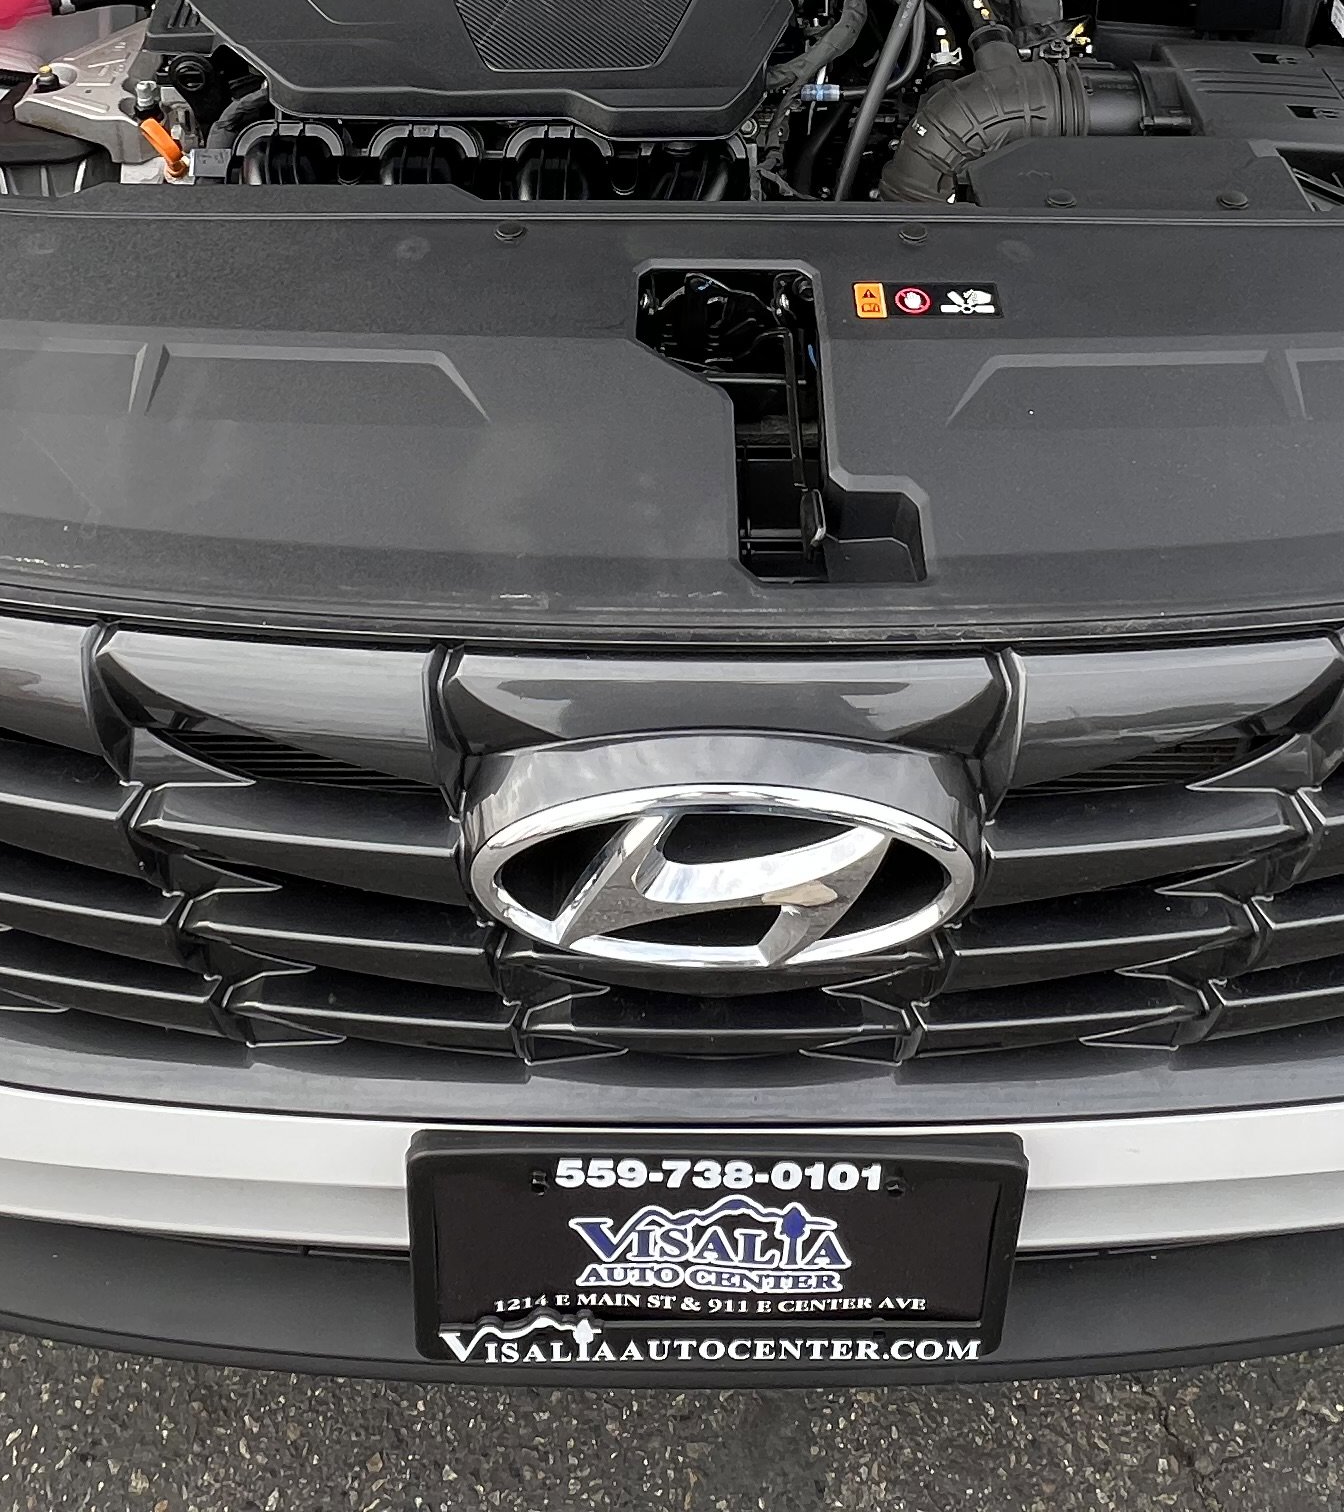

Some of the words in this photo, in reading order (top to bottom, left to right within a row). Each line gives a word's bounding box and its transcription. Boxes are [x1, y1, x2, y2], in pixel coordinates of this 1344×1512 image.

[555, 1158, 883, 1190] 559-738-0101
[569, 1196, 852, 1269] VISALIA
[576, 1263, 684, 1286] AUTO
[684, 1265, 843, 1292] CENTER
[494, 1293, 549, 1313] 1214
[556, 1294, 570, 1306] E
[577, 1293, 641, 1307] MAIN
[647, 1295, 676, 1310] ST
[680, 1297, 701, 1311] &
[708, 1298, 748, 1313] 911
[756, 1299, 772, 1313] E
[777, 1297, 873, 1312] CENTER
[878, 1297, 926, 1311] AVE
[439, 1316, 981, 1363] VISALIAAUTOCENTER.COM
